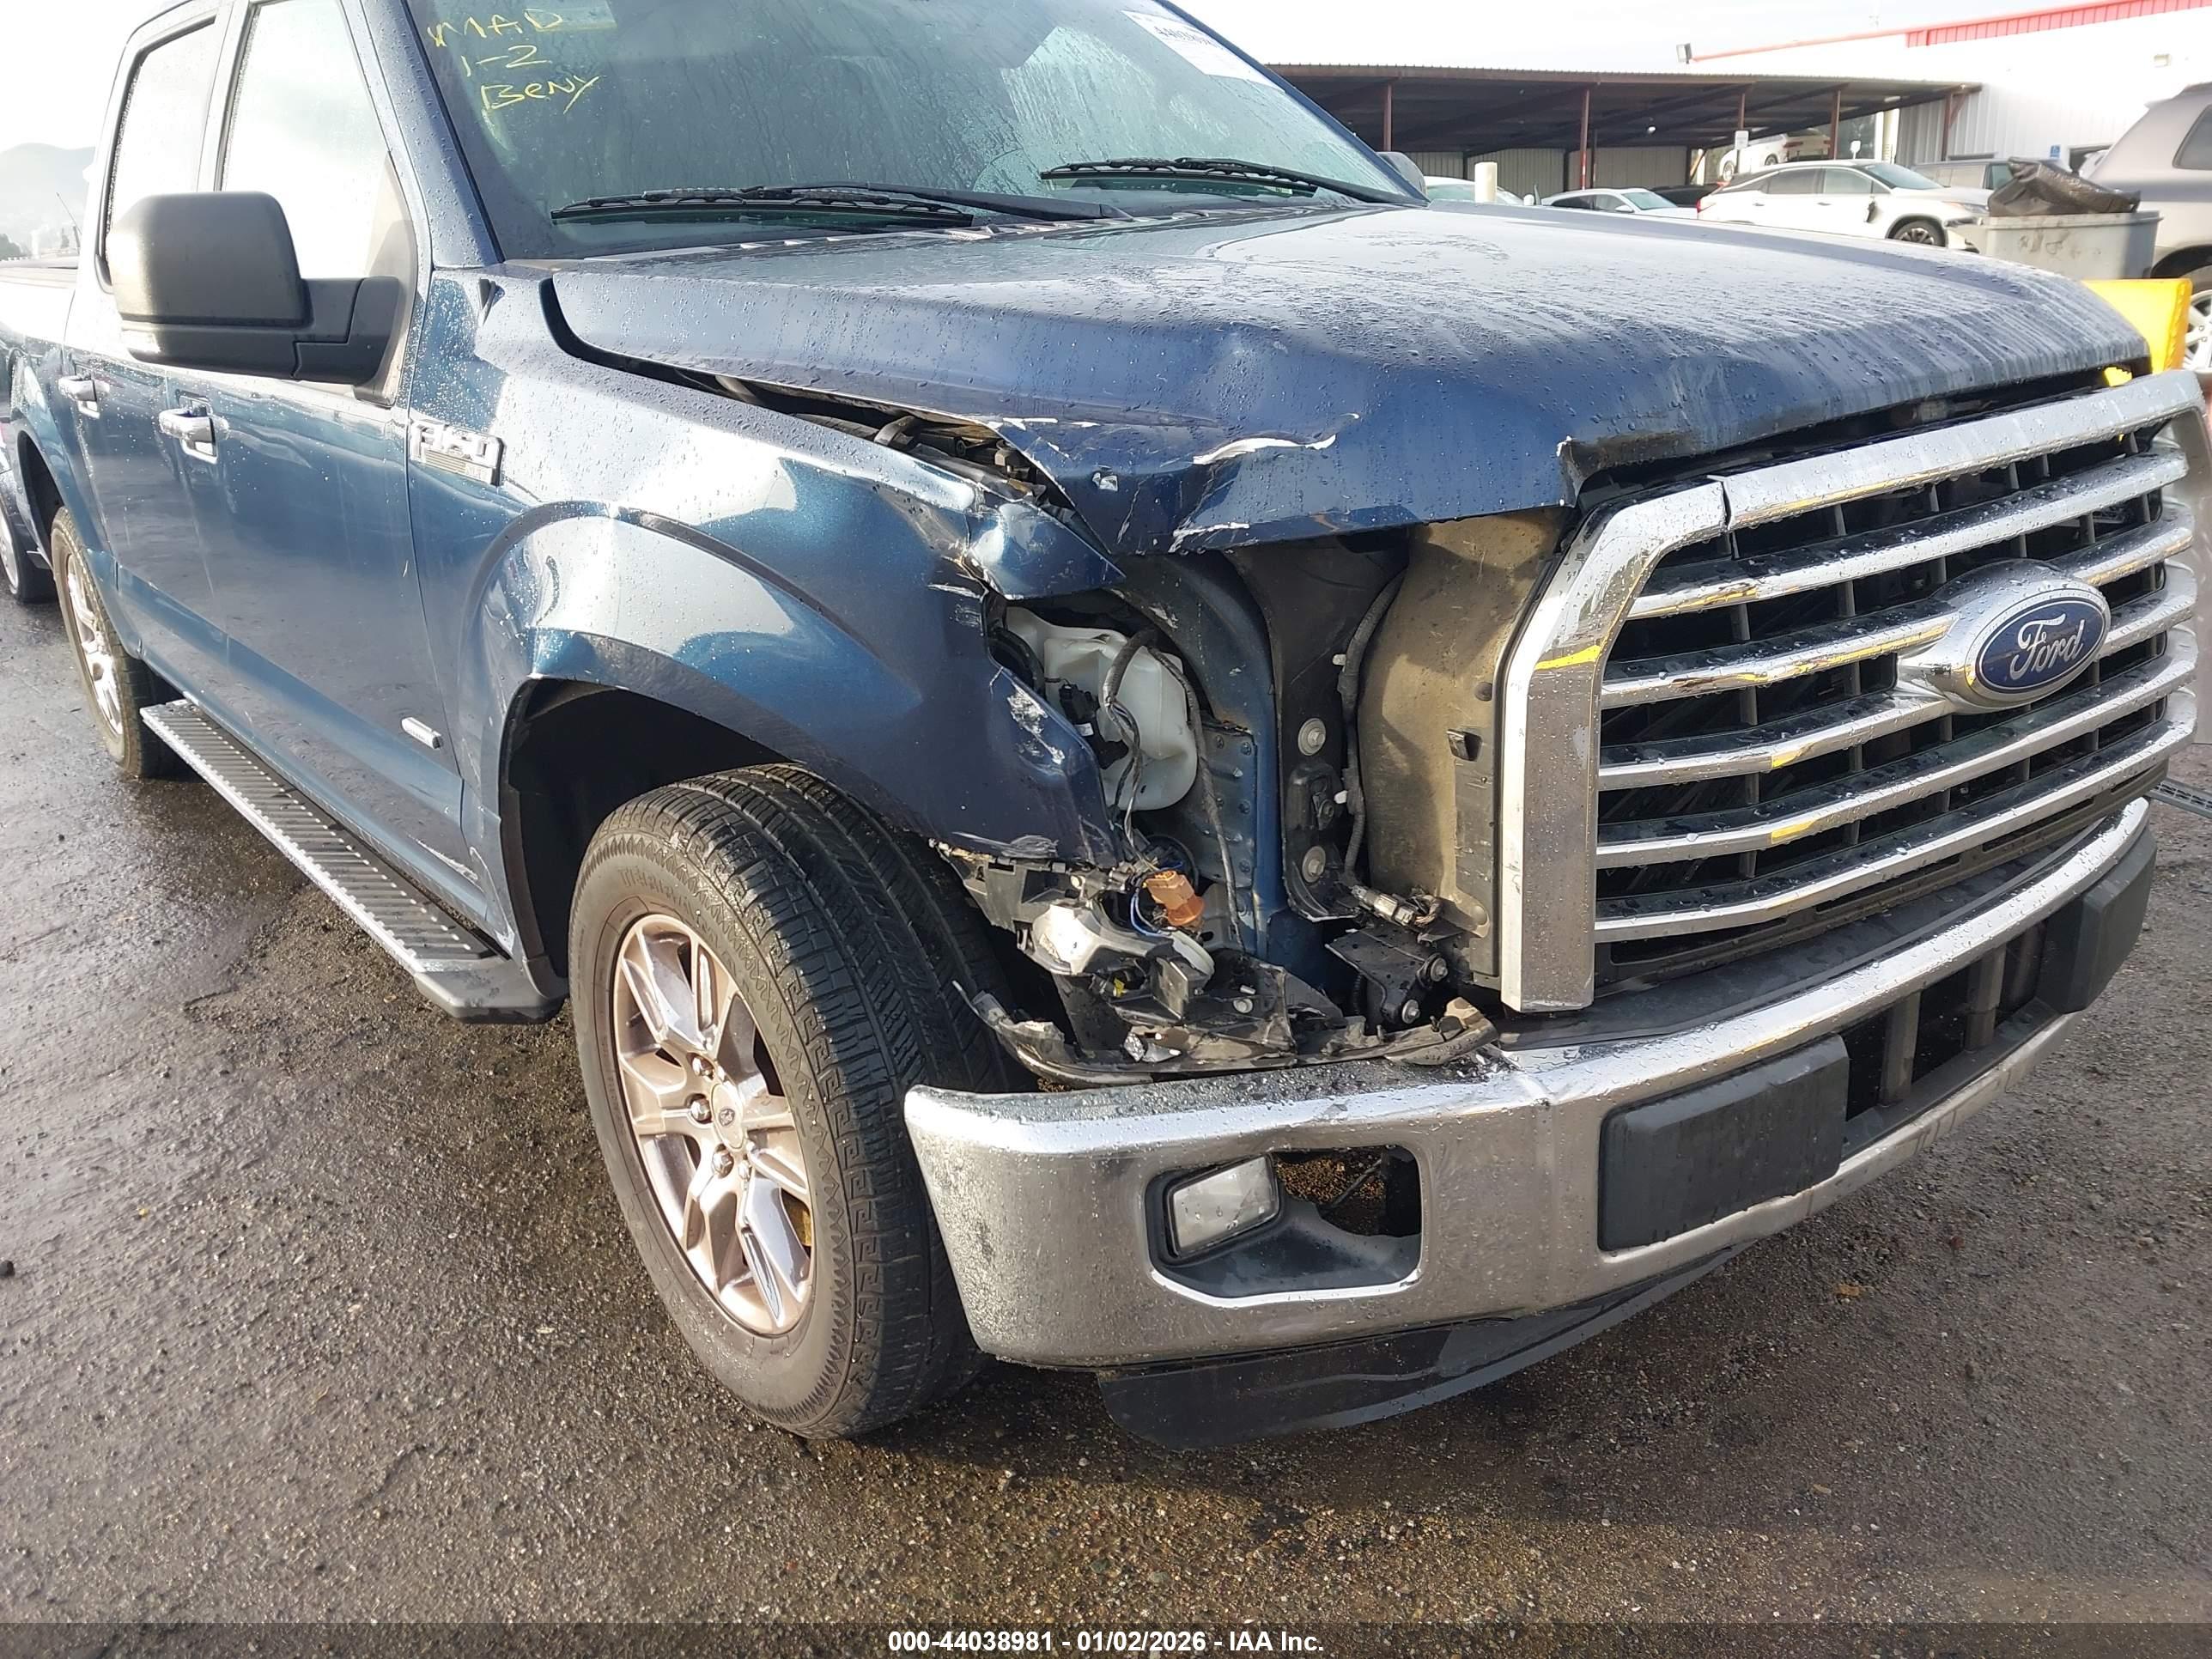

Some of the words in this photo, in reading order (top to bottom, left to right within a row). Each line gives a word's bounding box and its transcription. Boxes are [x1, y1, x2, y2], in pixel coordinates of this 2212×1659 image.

[428, 9, 563, 46] MAD
[460, 45, 552, 76] 1-2
[2009, 613, 2085, 680] Ford
